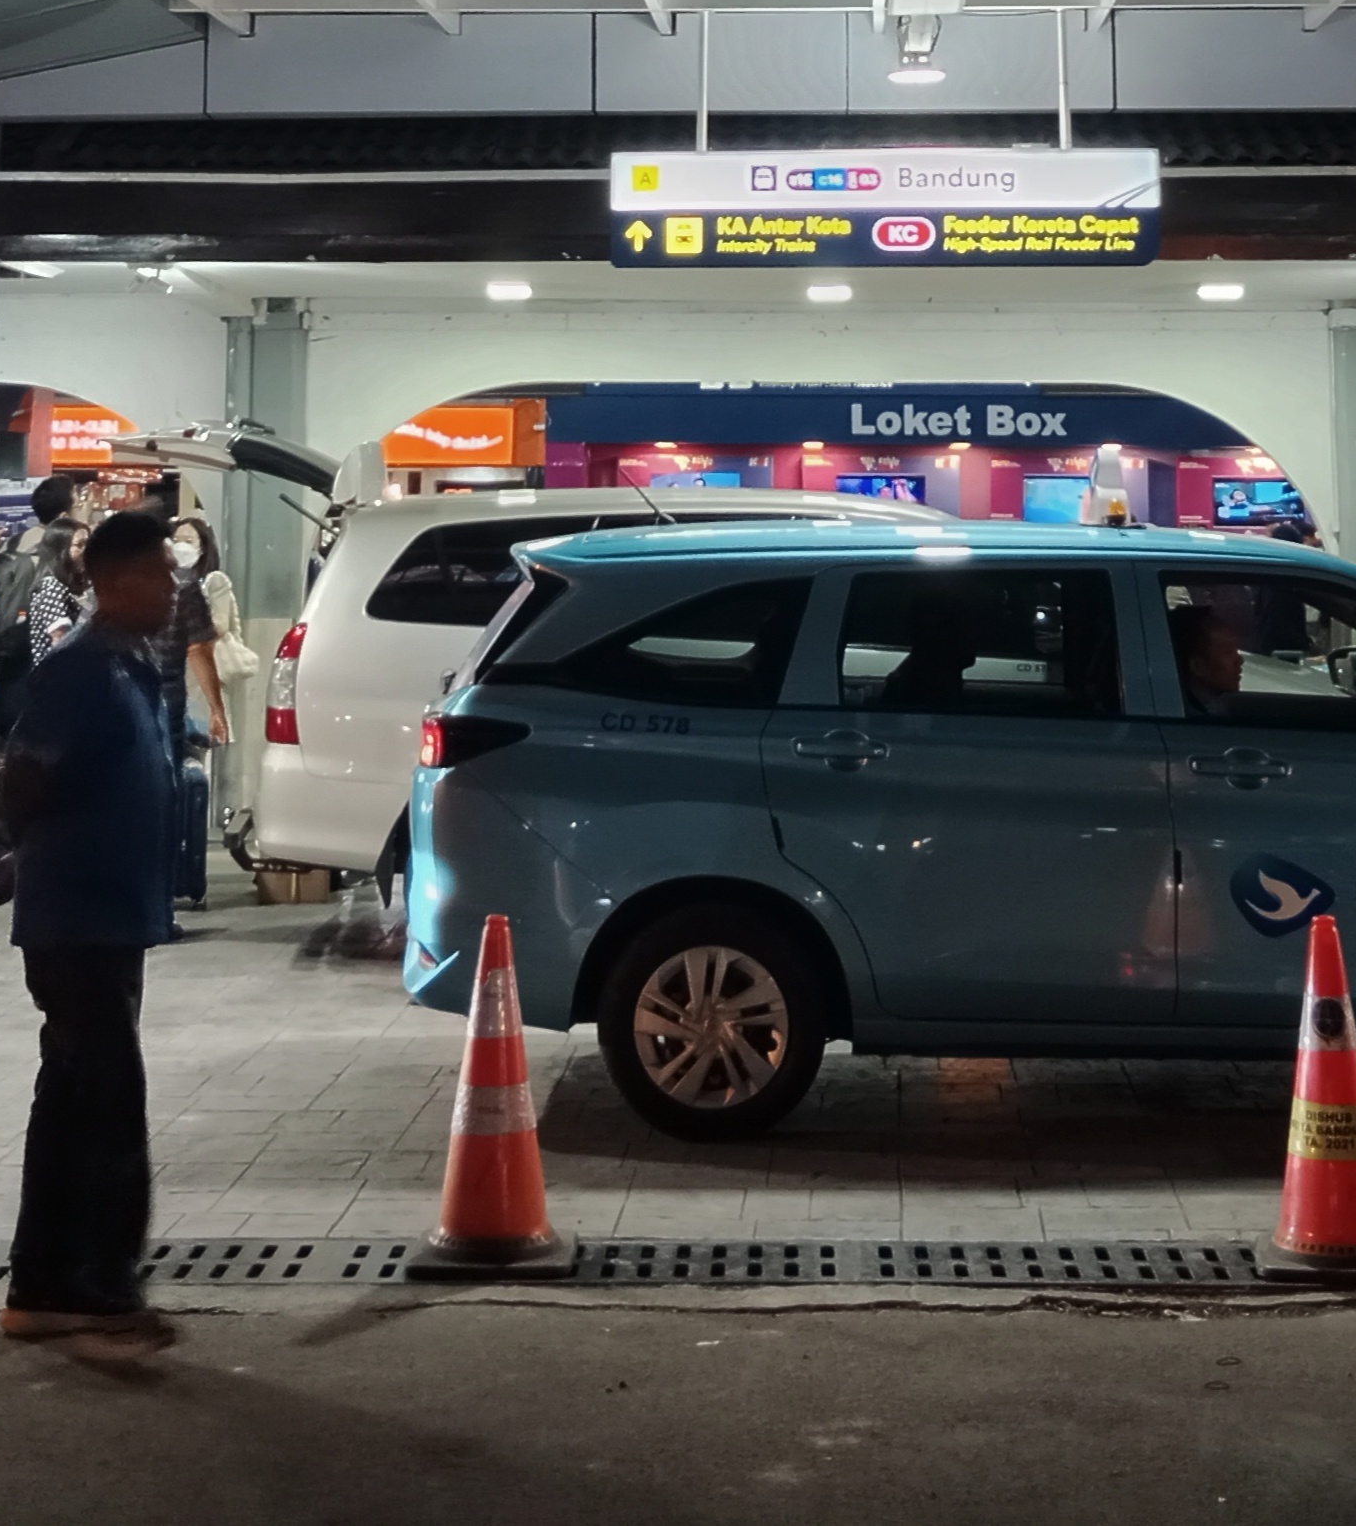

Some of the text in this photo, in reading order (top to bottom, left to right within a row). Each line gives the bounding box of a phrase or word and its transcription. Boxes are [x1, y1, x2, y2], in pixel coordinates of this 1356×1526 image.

[639, 172, 652, 185] A
[899, 167, 1016, 192] Bandung
[717, 216, 852, 235] KA Antar Kota
[887, 225, 920, 243] KC
[944, 215, 1140, 237] Feeder Kereta Cepat
[717, 239, 816, 255] Intercity Trains
[944, 237, 1135, 253] High-Speed Rail Feeder Line
[850, 403, 1067, 436] Loket Box
[600, 711, 691, 735] CD 578
[1305, 1111, 1353, 1124] DISHUB
[1325, 1137, 1356, 1150] 2021
